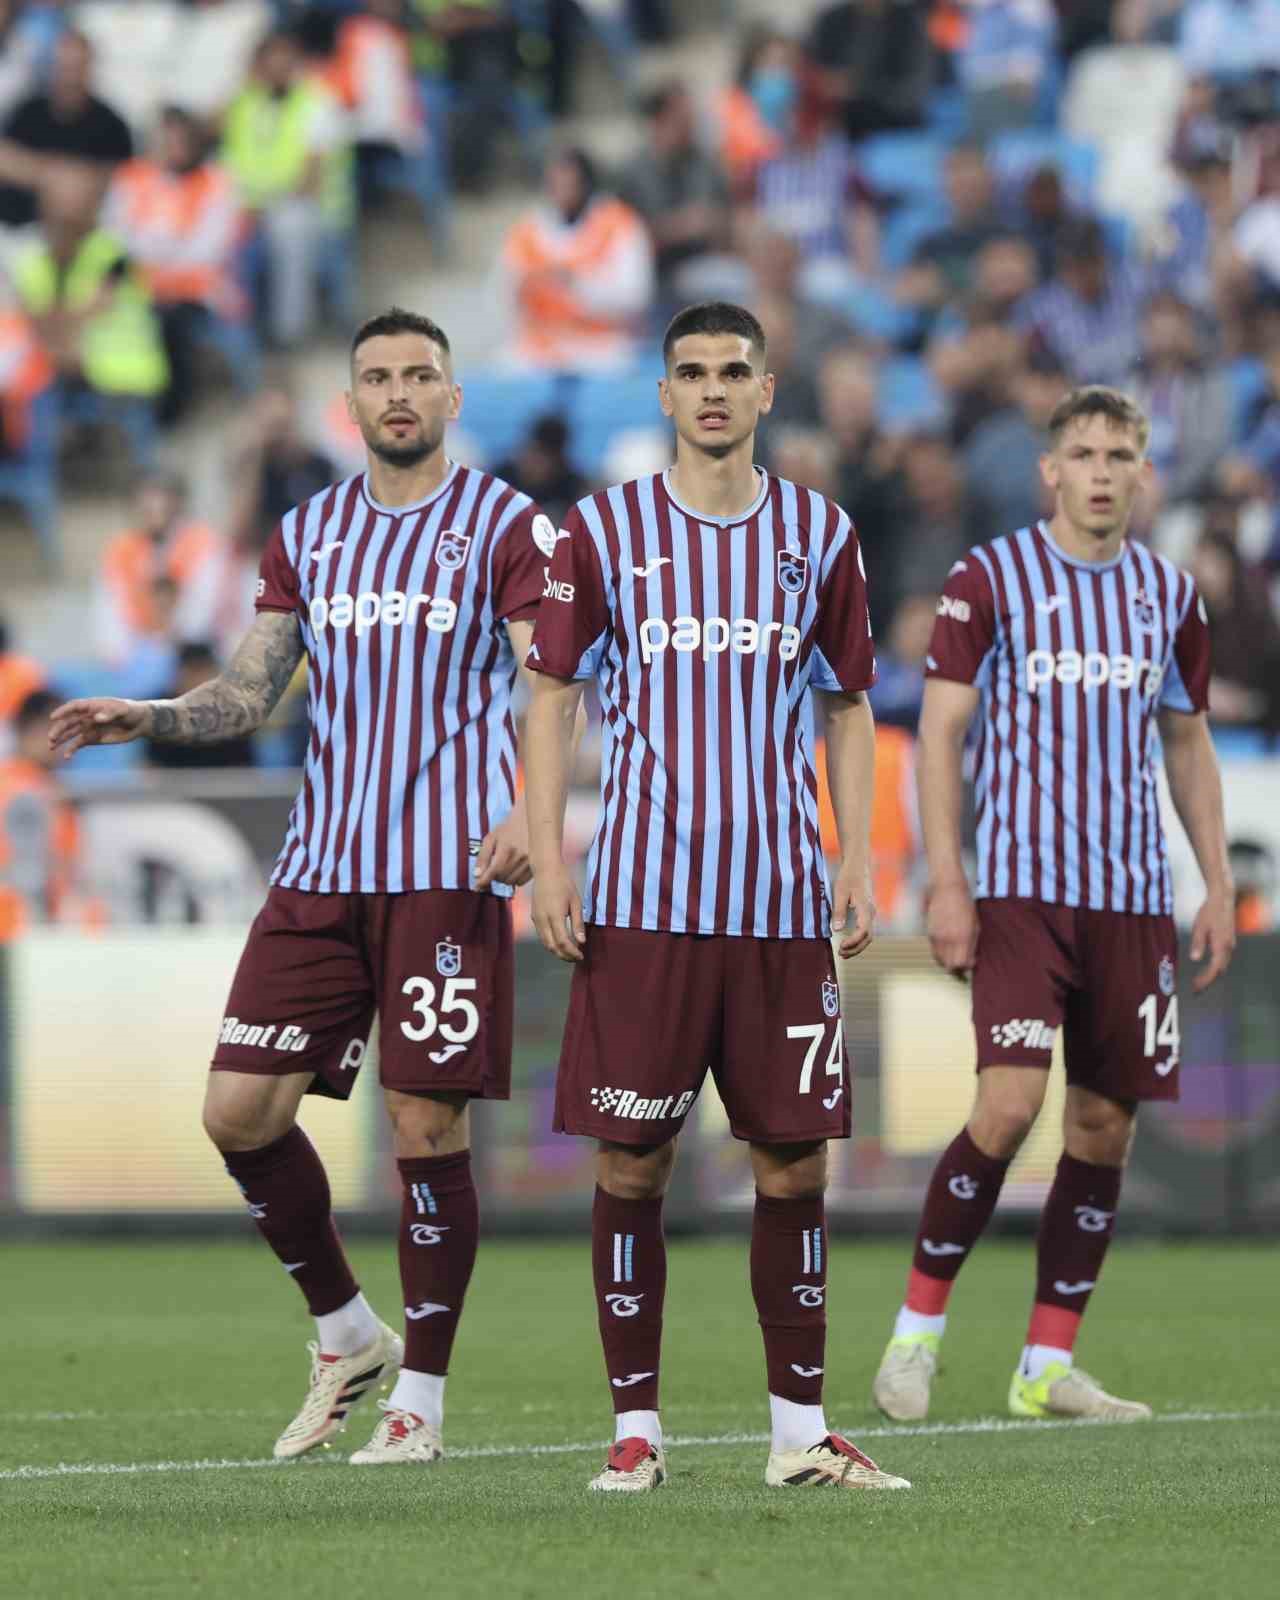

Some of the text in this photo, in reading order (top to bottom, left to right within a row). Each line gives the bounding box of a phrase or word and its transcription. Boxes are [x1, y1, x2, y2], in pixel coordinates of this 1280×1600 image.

[309, 591, 457, 643] papara
[639, 616, 801, 664] papara
[1026, 649, 1163, 696] papara
[401, 976, 479, 1043] 35
[1138, 994, 1180, 1056] 14
[274, 1025, 311, 1051] Go
[786, 1018, 843, 1094] 74
[613, 1090, 674, 1119] Rent
